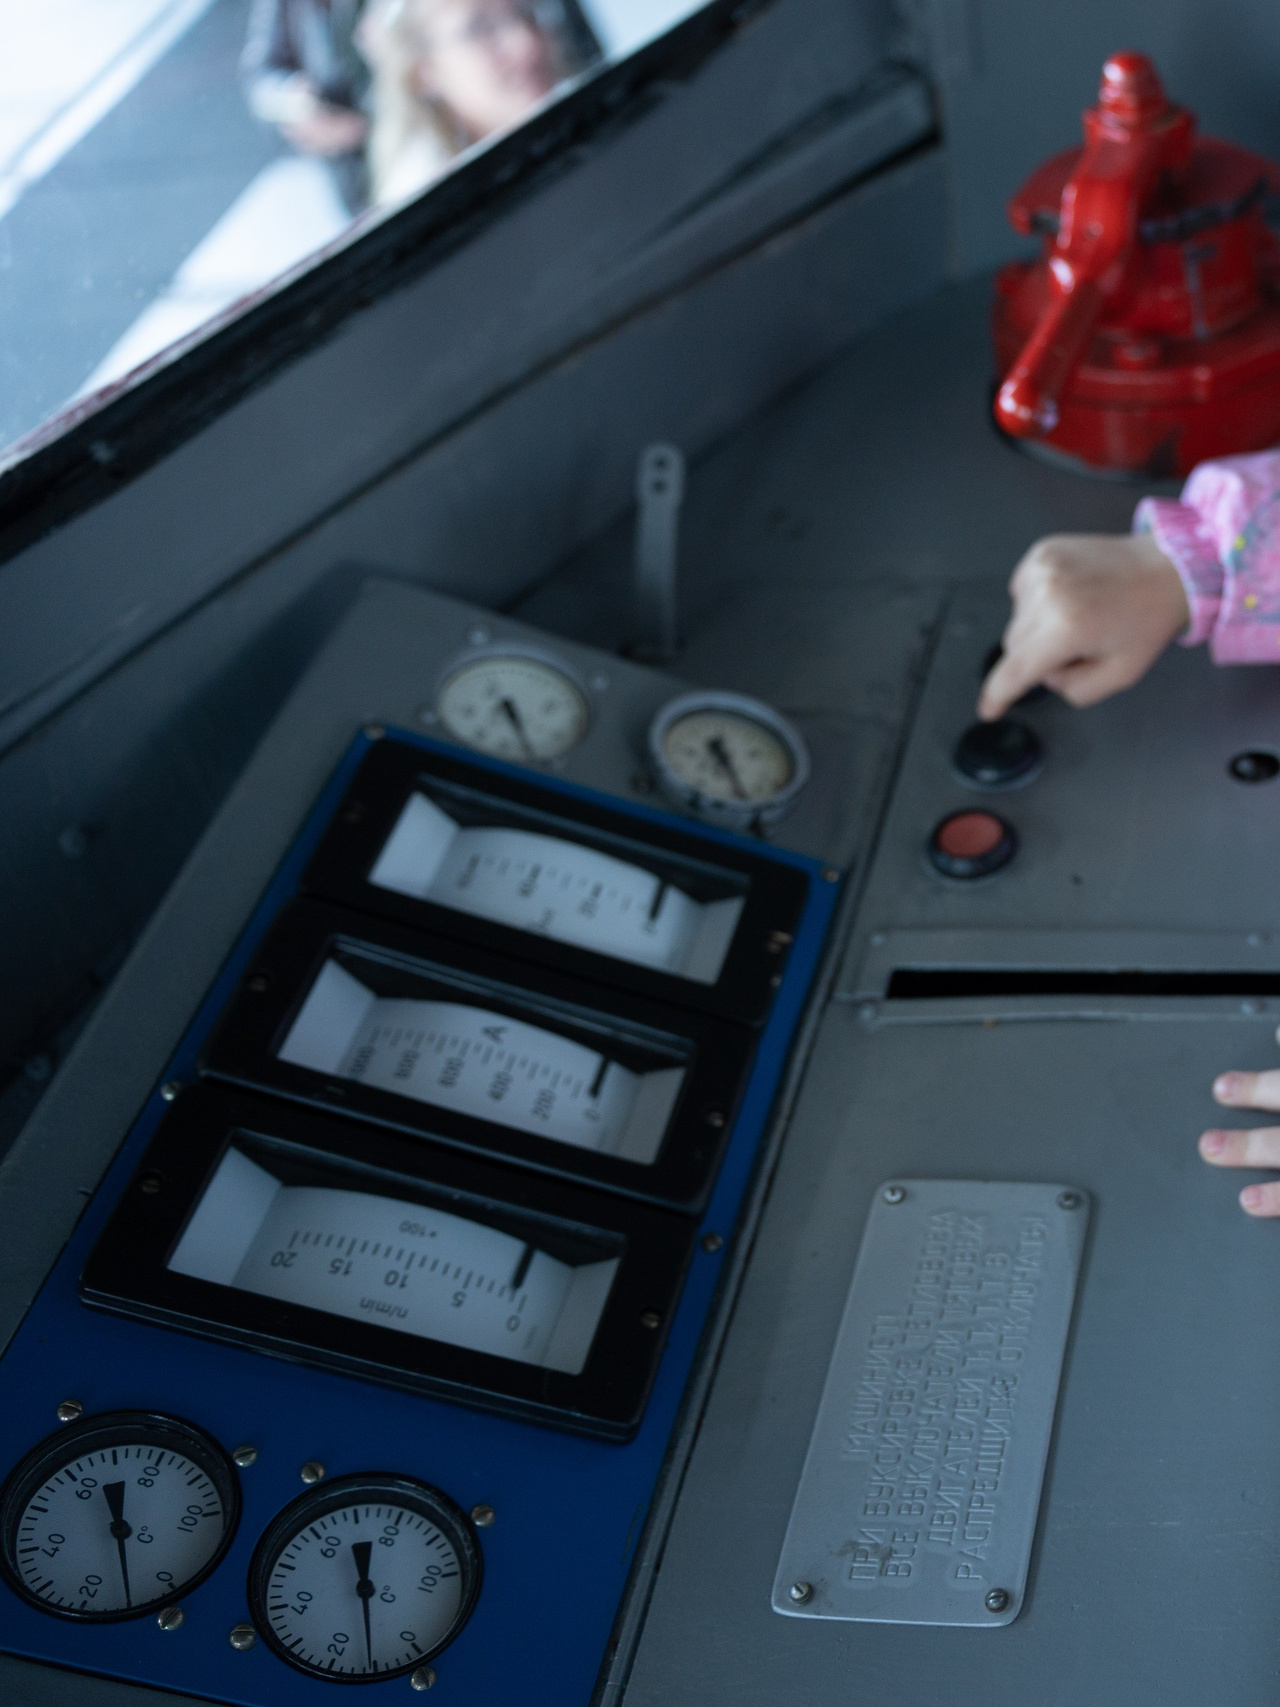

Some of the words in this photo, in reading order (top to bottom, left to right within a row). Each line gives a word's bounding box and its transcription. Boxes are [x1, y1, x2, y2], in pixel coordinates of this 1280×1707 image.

[270, 1250, 298, 1268] 20
[328, 1257, 353, 1276] 15
[384, 1270, 408, 1289] 10
[359, 1297, 409, 1320] n/min
[452, 1291, 467, 1308] 5
[506, 1315, 521, 1332] 0
[896, 1329, 962, 1515] ВЫКЛЮЧАТЕЛИ
[862, 1358, 923, 1516] БУКСИРОВКЕ
[923, 1377, 986, 1545] ДВИГАТЕЛЕЙ
[138, 1466, 160, 1488] 80
[954, 1372, 1021, 1580] РАСПРЕДЩИТКЕ
[76, 1478, 97, 1499] 60
[177, 1505, 203, 1532] 100
[42, 1533, 65, 1557] 40
[320, 1535, 341, 1558] 60
[379, 1525, 399, 1547] 80
[848, 1526, 887, 1581] ПРИ
[883, 1527, 921, 1577] ВСЕ
[79, 1575, 103, 1598] 20
[156, 1571, 173, 1582] 0
[418, 1565, 442, 1593] 100
[291, 1591, 313, 1615] 40
[327, 1632, 349, 1656] 20
[400, 1630, 416, 1642] 0
